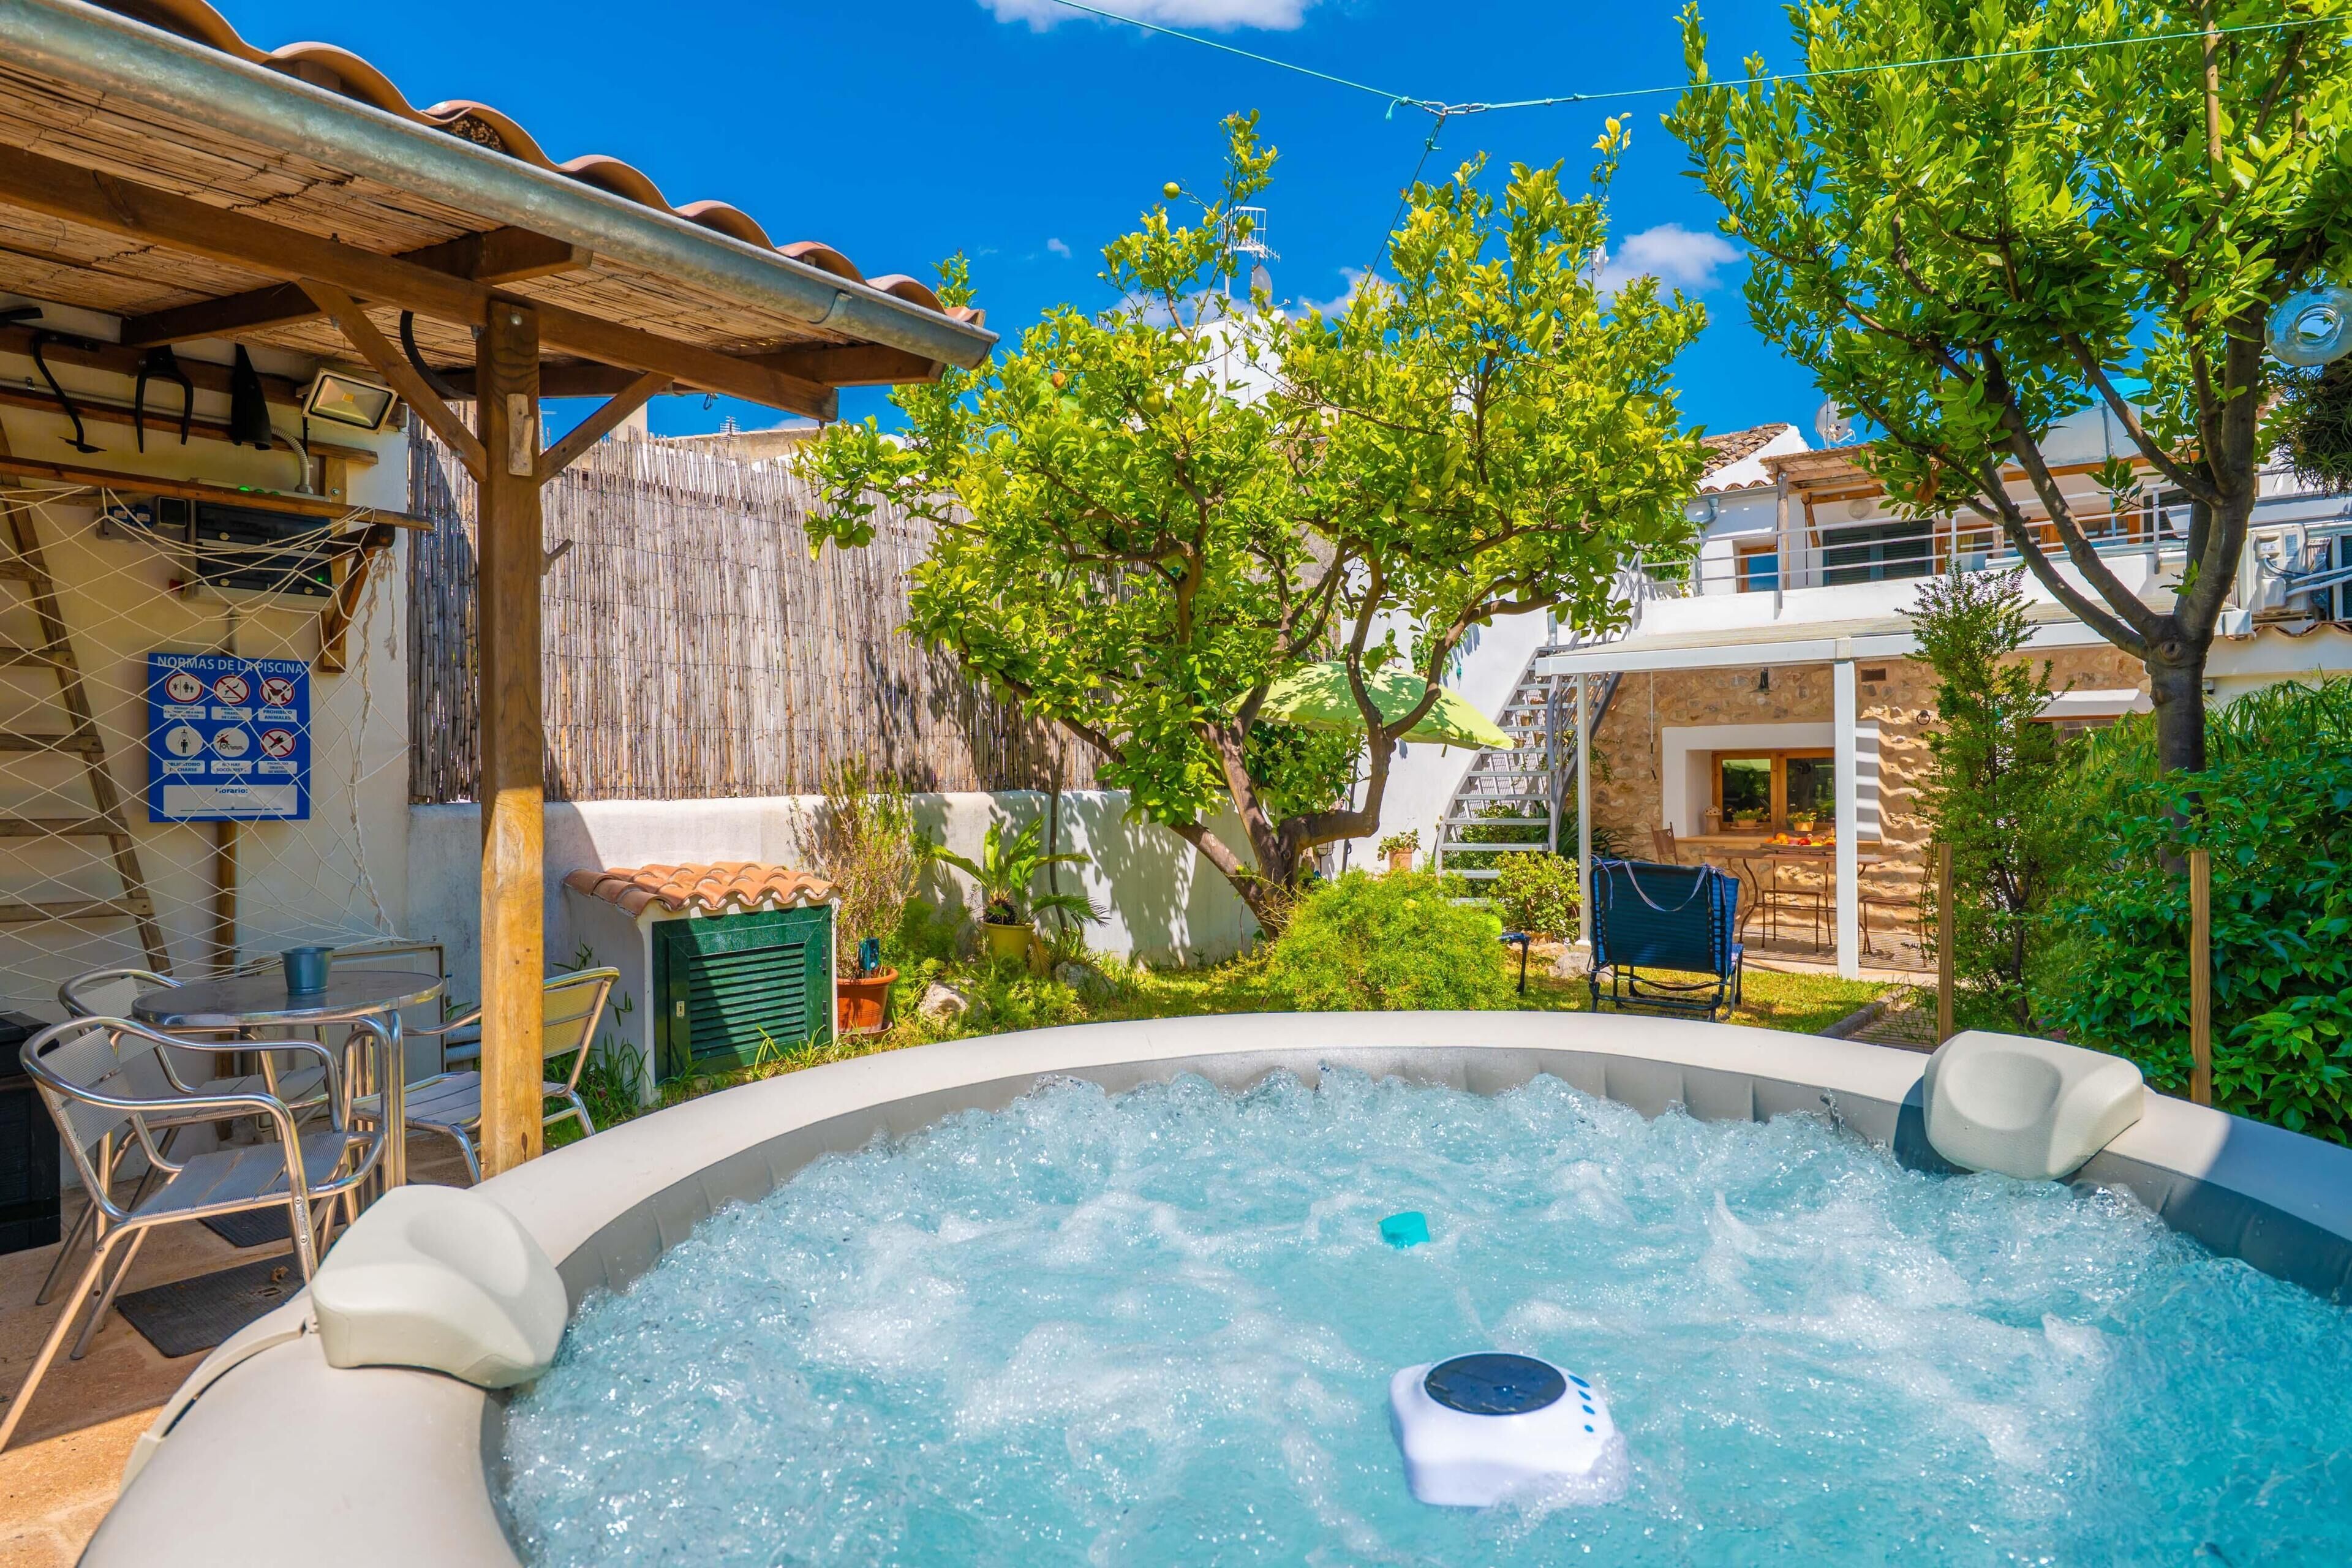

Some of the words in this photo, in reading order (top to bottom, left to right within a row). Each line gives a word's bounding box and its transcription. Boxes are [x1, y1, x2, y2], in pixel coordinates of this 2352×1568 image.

[157, 656, 214, 669] NORMAS
[218, 659, 234, 670] DE
[238, 660, 253, 671] LA
[257, 661, 303, 674] PISCINA
